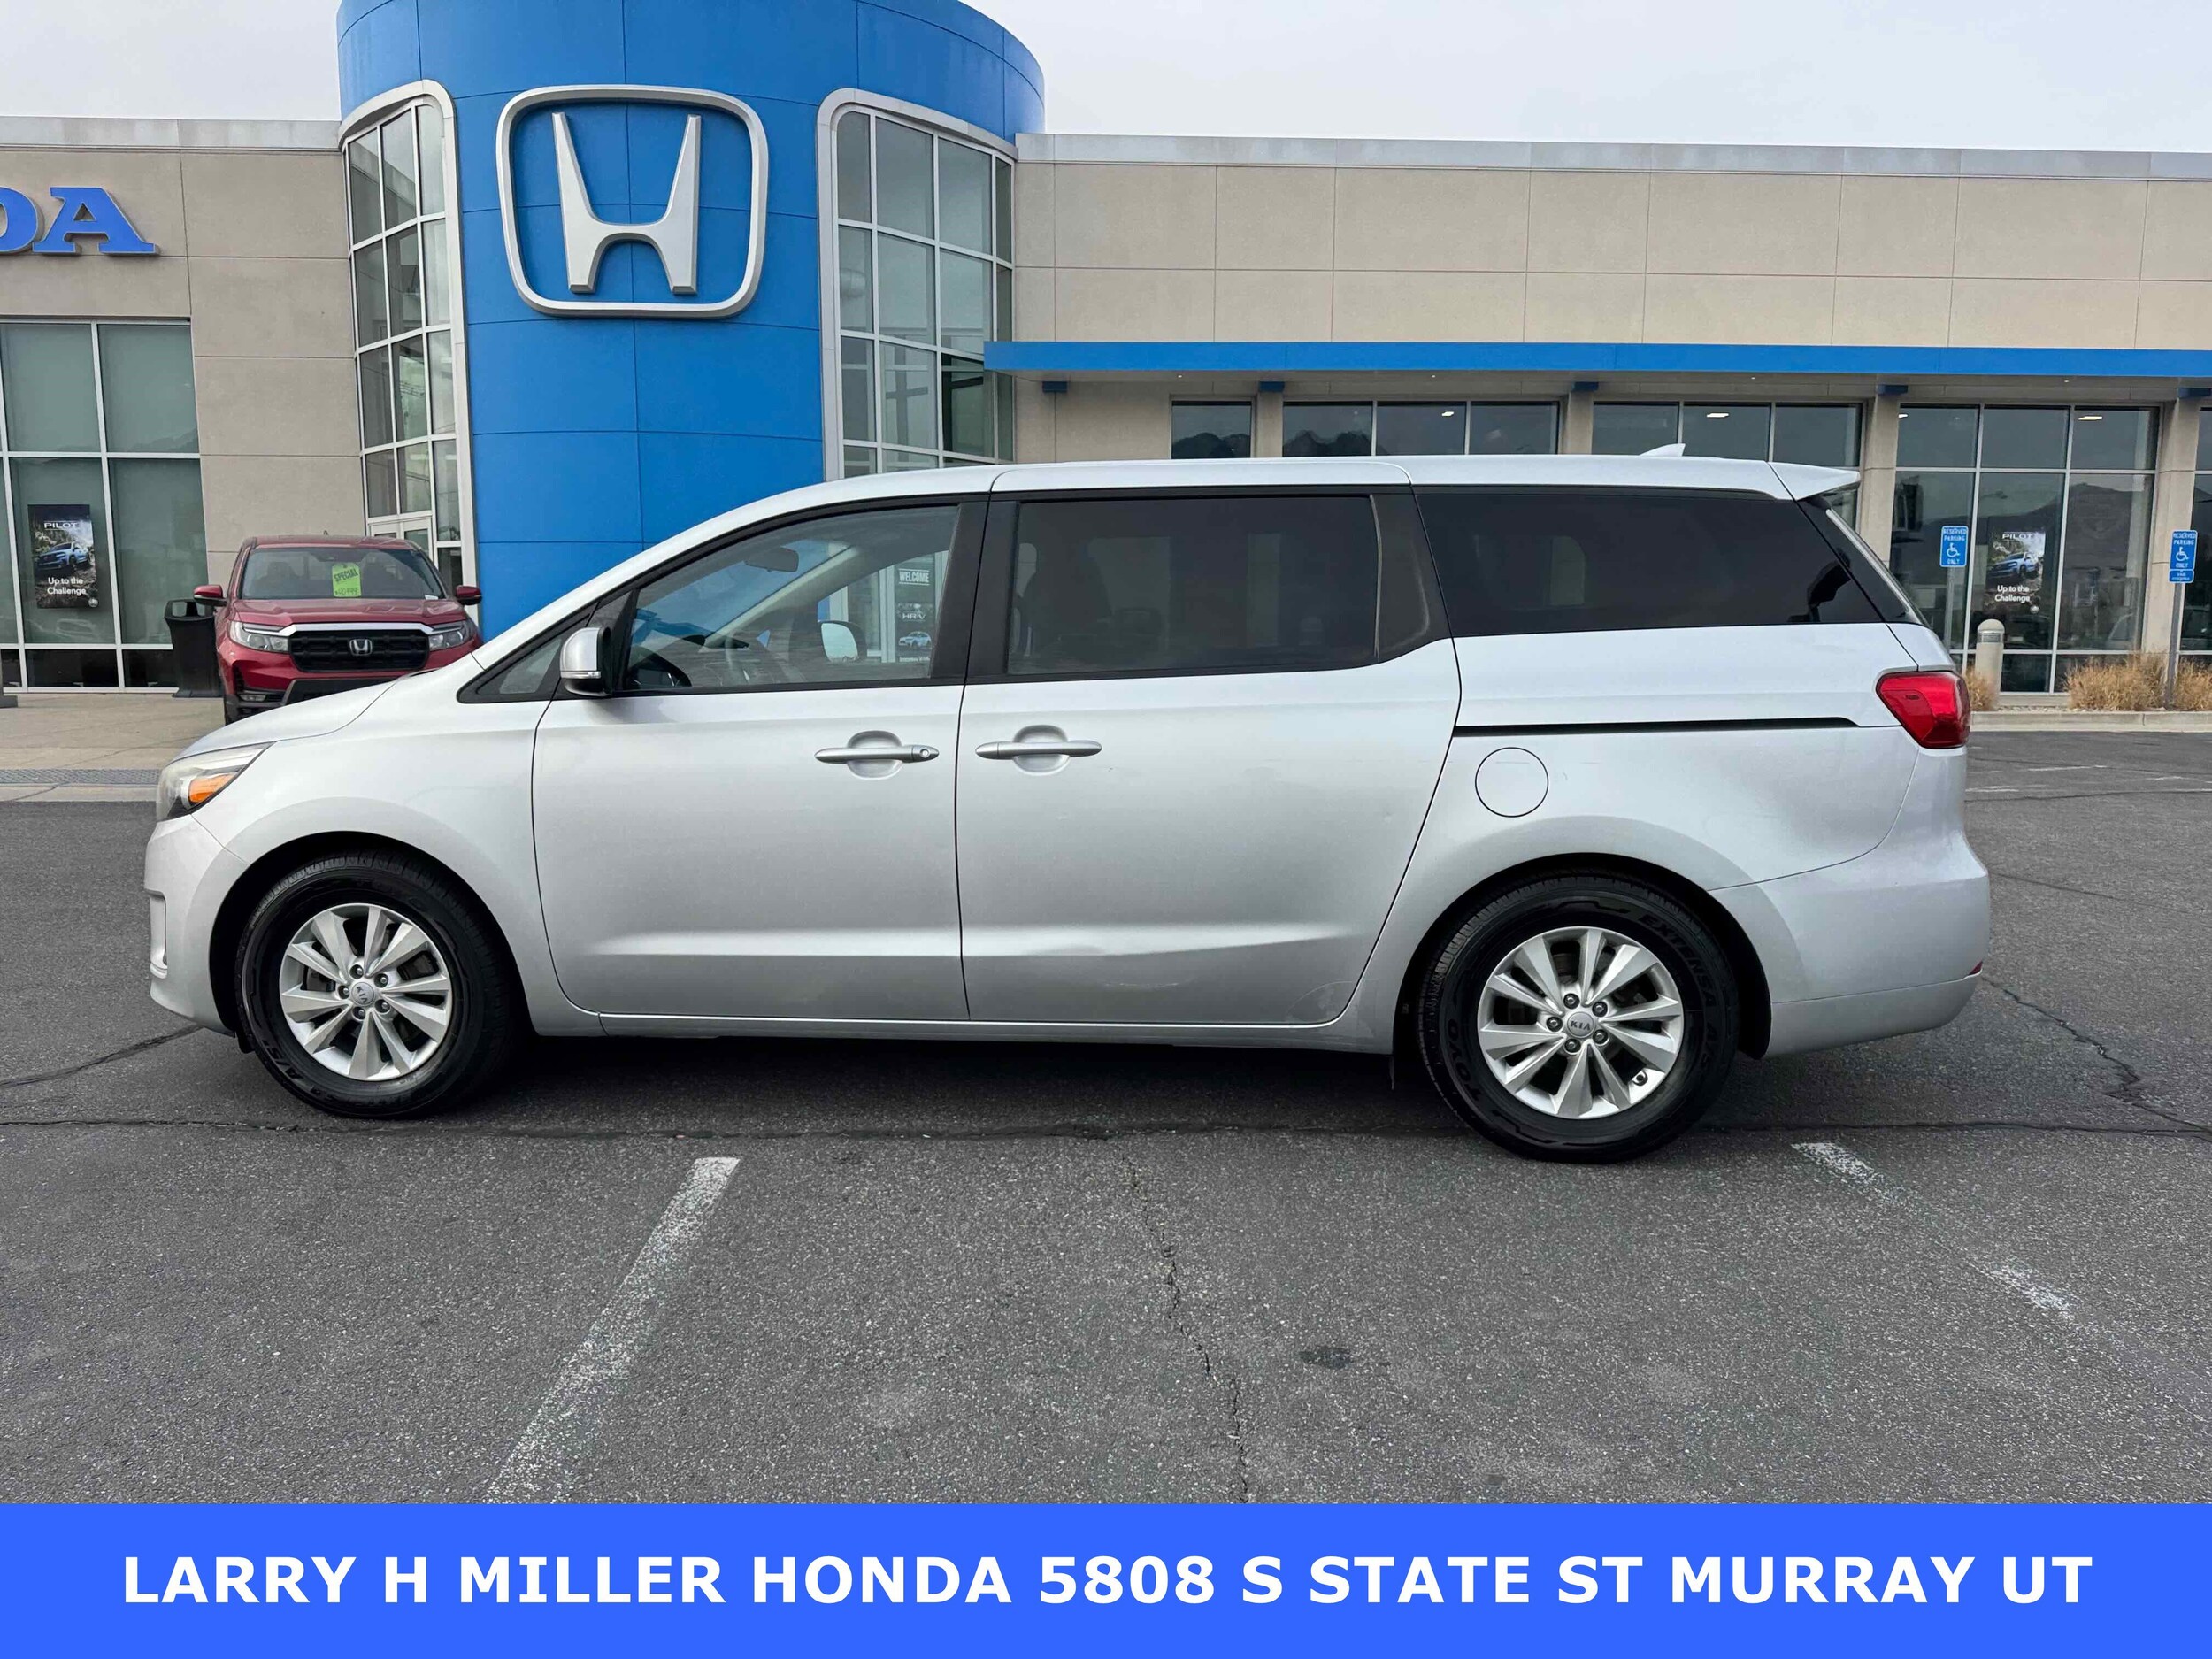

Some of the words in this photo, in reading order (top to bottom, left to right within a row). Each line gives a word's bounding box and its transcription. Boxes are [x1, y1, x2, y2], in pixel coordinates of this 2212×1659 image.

[334, 568, 359, 582] SPECIAL
[899, 571, 930, 583] WELCOME
[48, 577, 60, 587] Up
[47, 587, 87, 596] Challenge
[1997, 585, 2008, 594] Up
[1994, 594, 2031, 604] Challenge
[1638, 914, 1717, 1006] EXTENSA
[1571, 1020, 1591, 1031] KIA
[1448, 1018, 1482, 1102] TOYO
